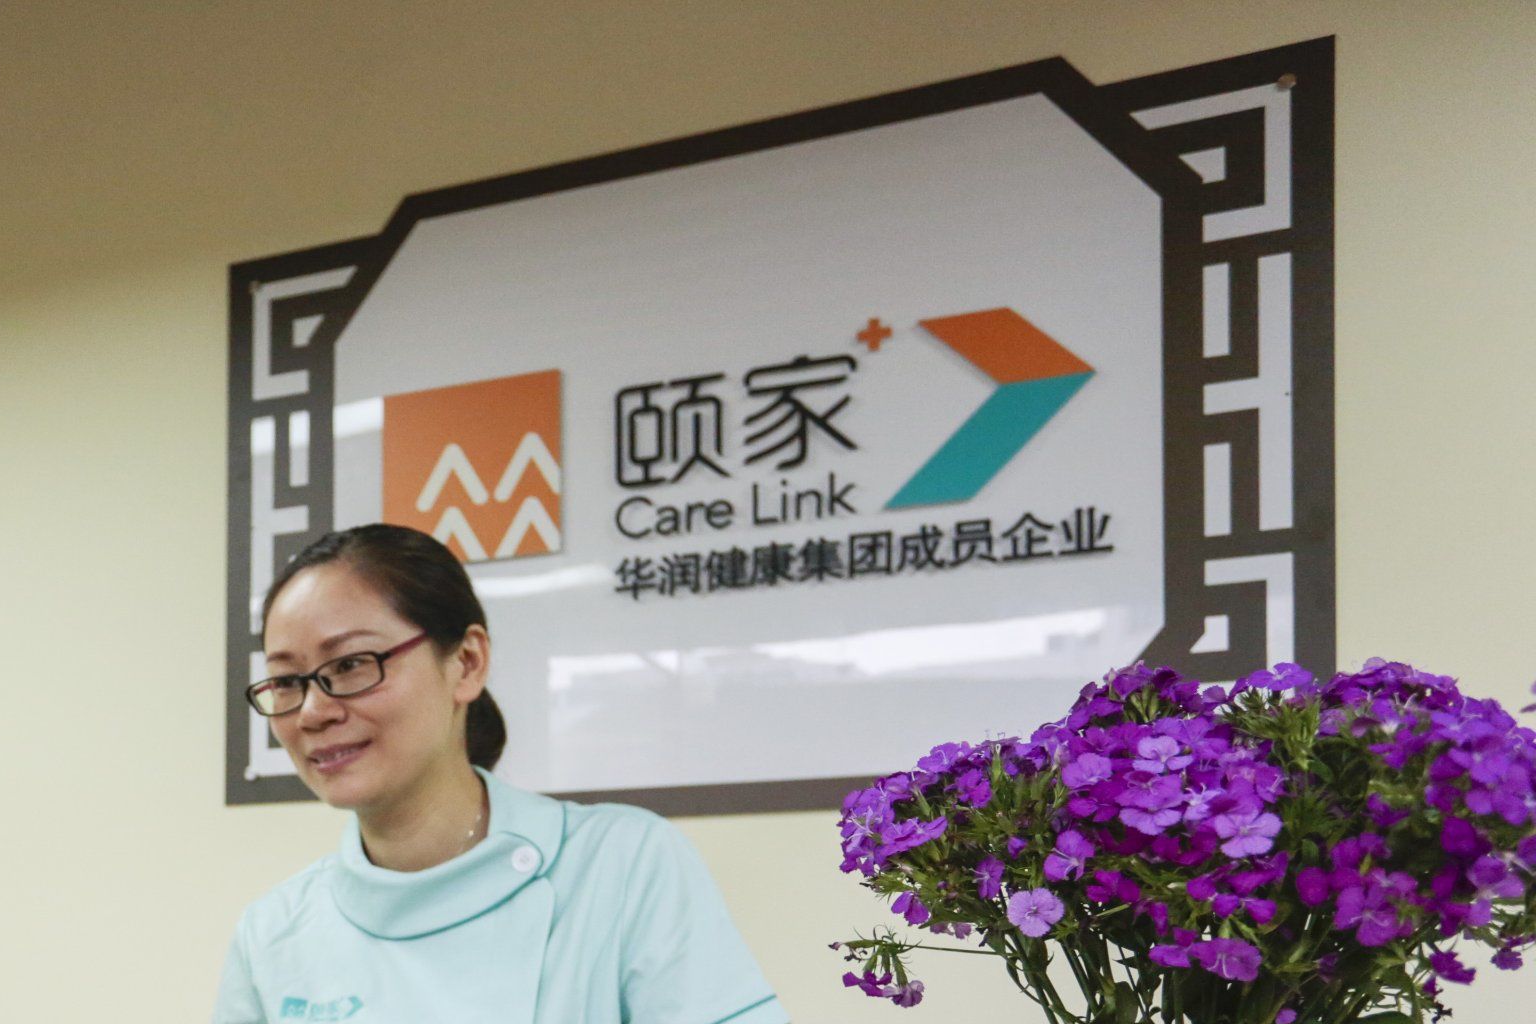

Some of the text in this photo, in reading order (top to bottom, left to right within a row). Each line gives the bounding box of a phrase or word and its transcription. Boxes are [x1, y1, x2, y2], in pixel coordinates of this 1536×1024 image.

[615, 354, 860, 489] 颐家
[616, 471, 858, 540] Care Link
[615, 507, 1115, 600] 华润健康集团成员企业
